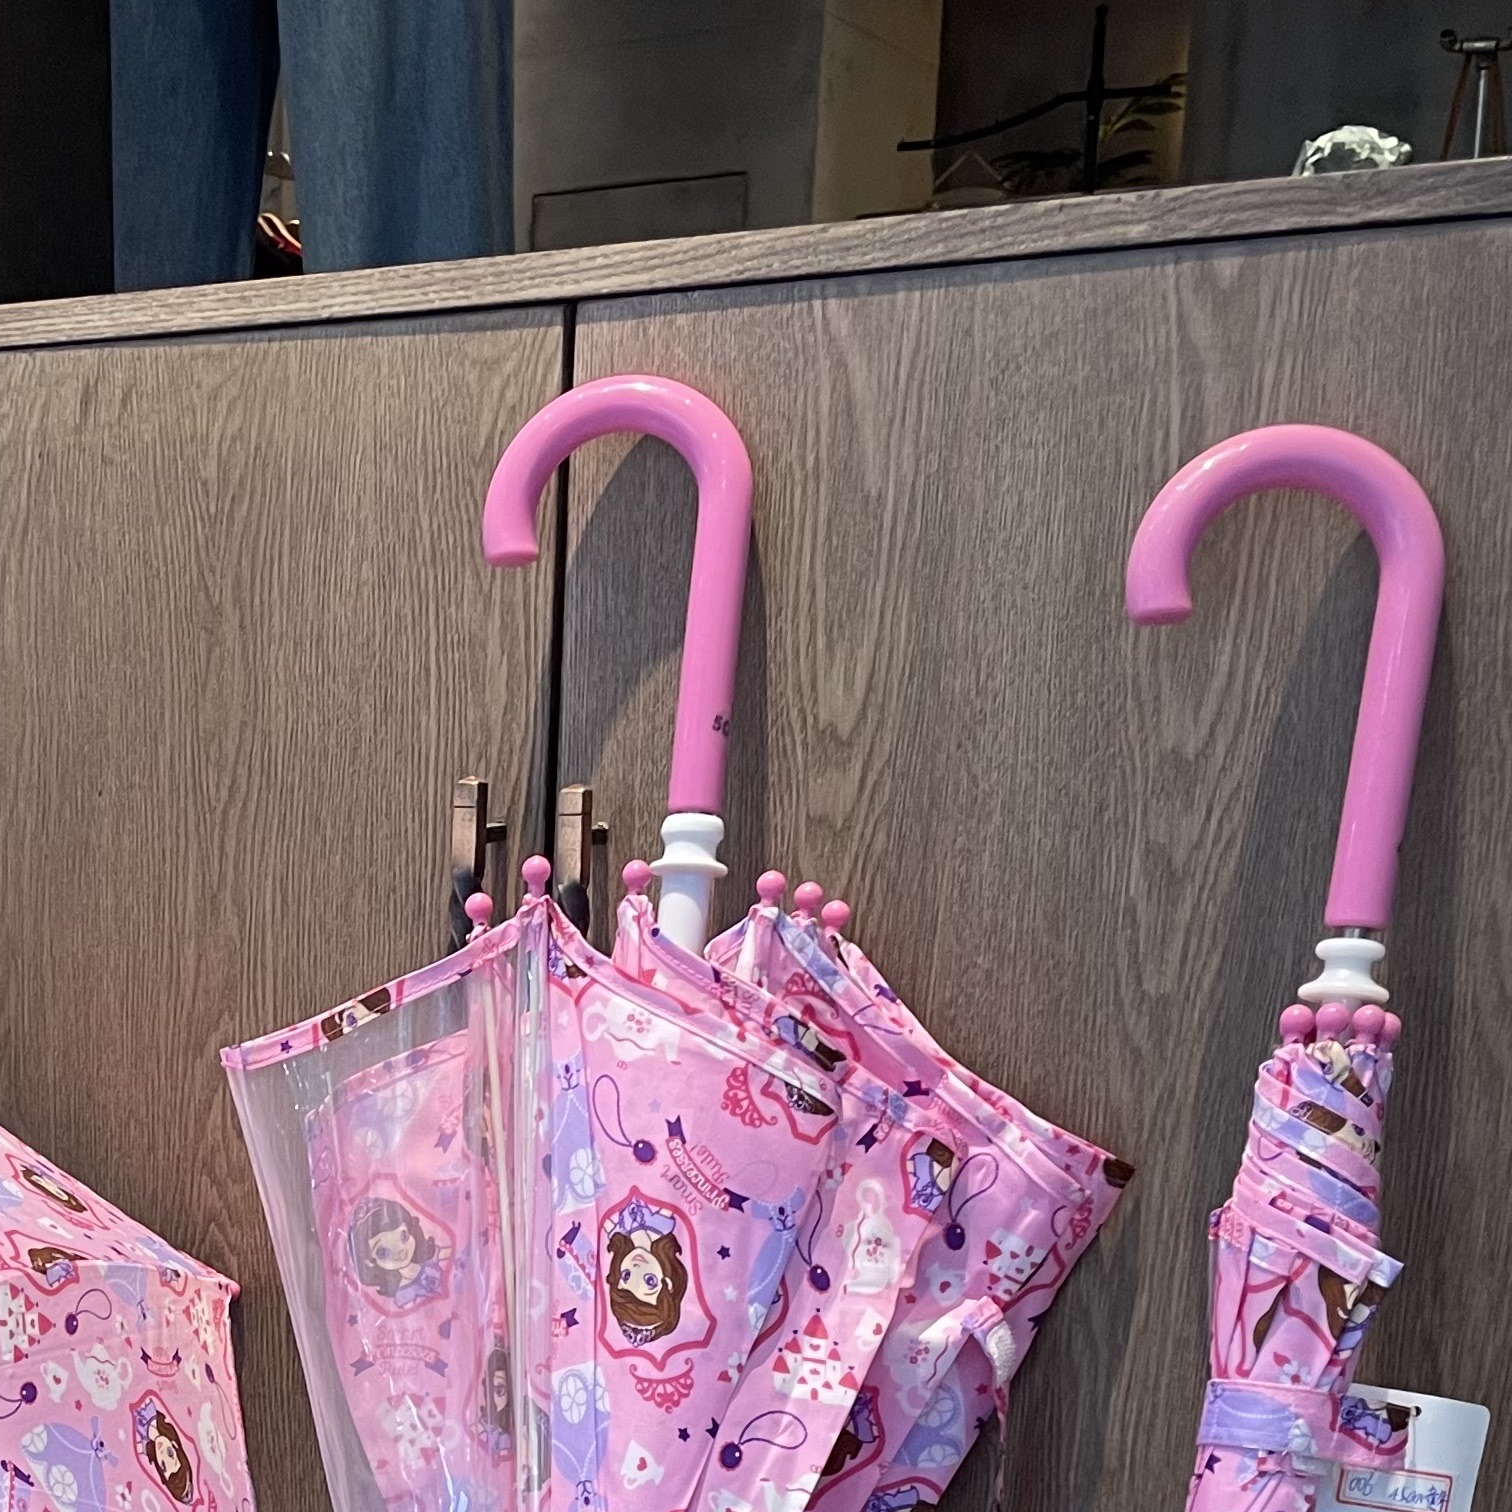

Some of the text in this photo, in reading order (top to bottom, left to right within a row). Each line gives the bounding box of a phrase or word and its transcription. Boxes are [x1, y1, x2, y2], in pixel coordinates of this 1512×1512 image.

[668, 1139, 729, 1211] Princesses
[690, 1143, 730, 1184] Rule!
[660, 1164, 703, 1216] Smart
